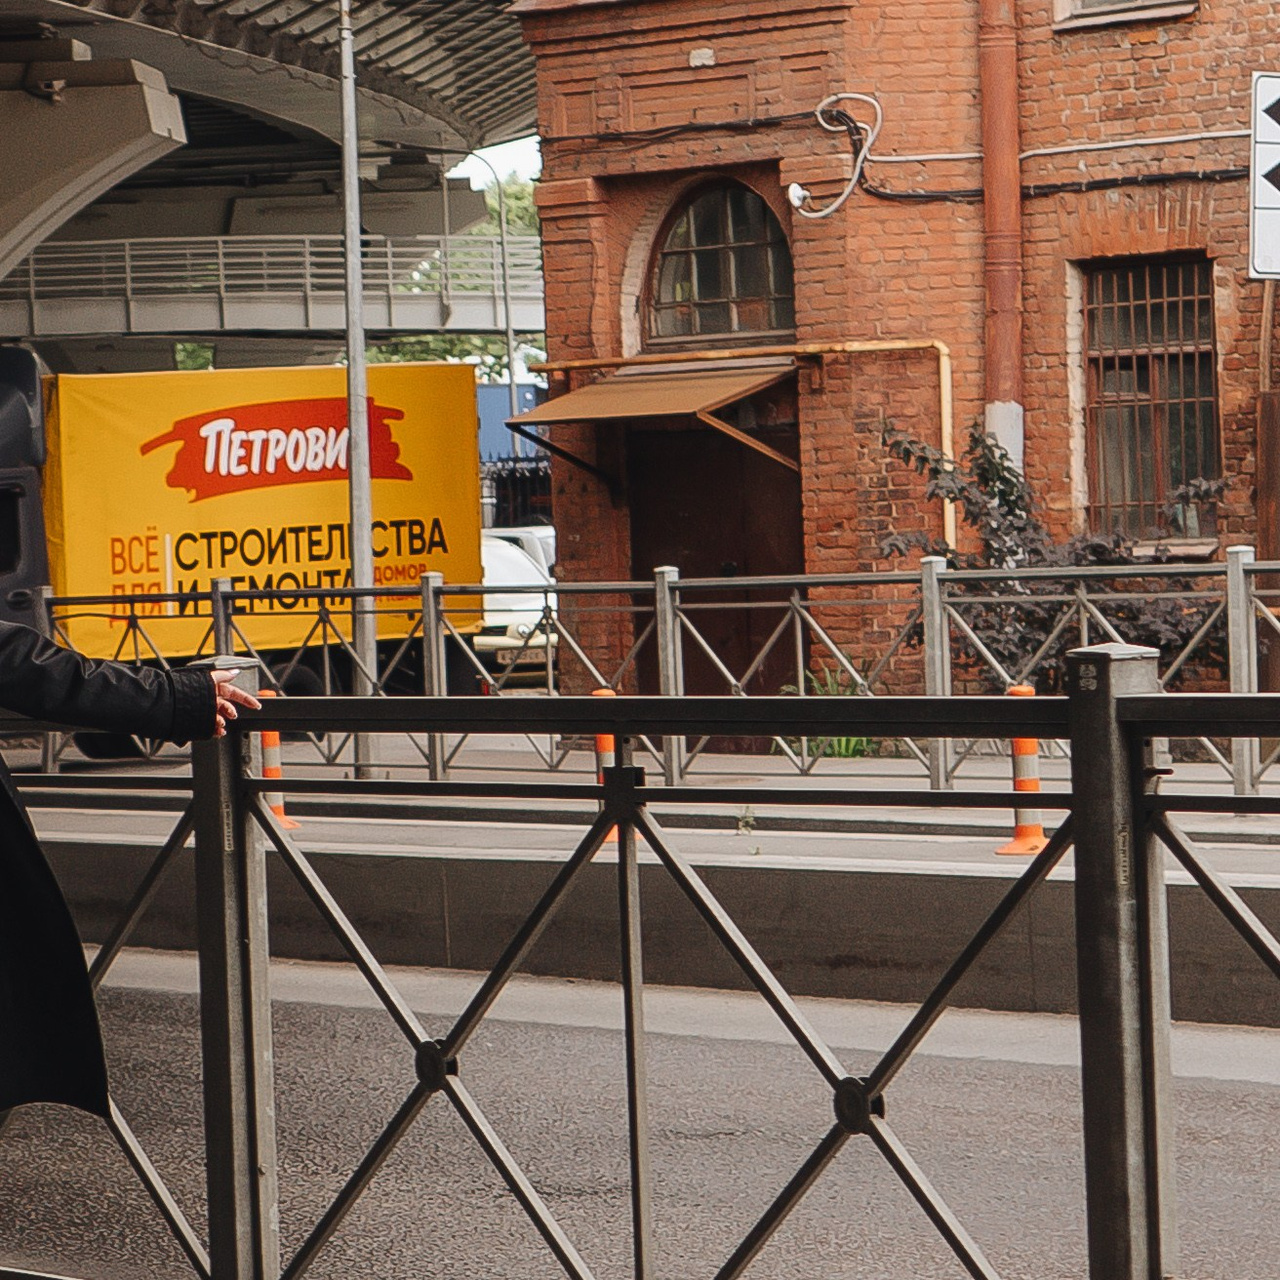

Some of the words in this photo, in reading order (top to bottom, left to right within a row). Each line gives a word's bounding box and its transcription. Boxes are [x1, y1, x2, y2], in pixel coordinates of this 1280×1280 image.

[199, 418, 350, 476] ПЕТРОВИ
[110, 525, 160, 575] ВСЁ
[174, 517, 449, 571] СТРОИТЕЛСТВА
